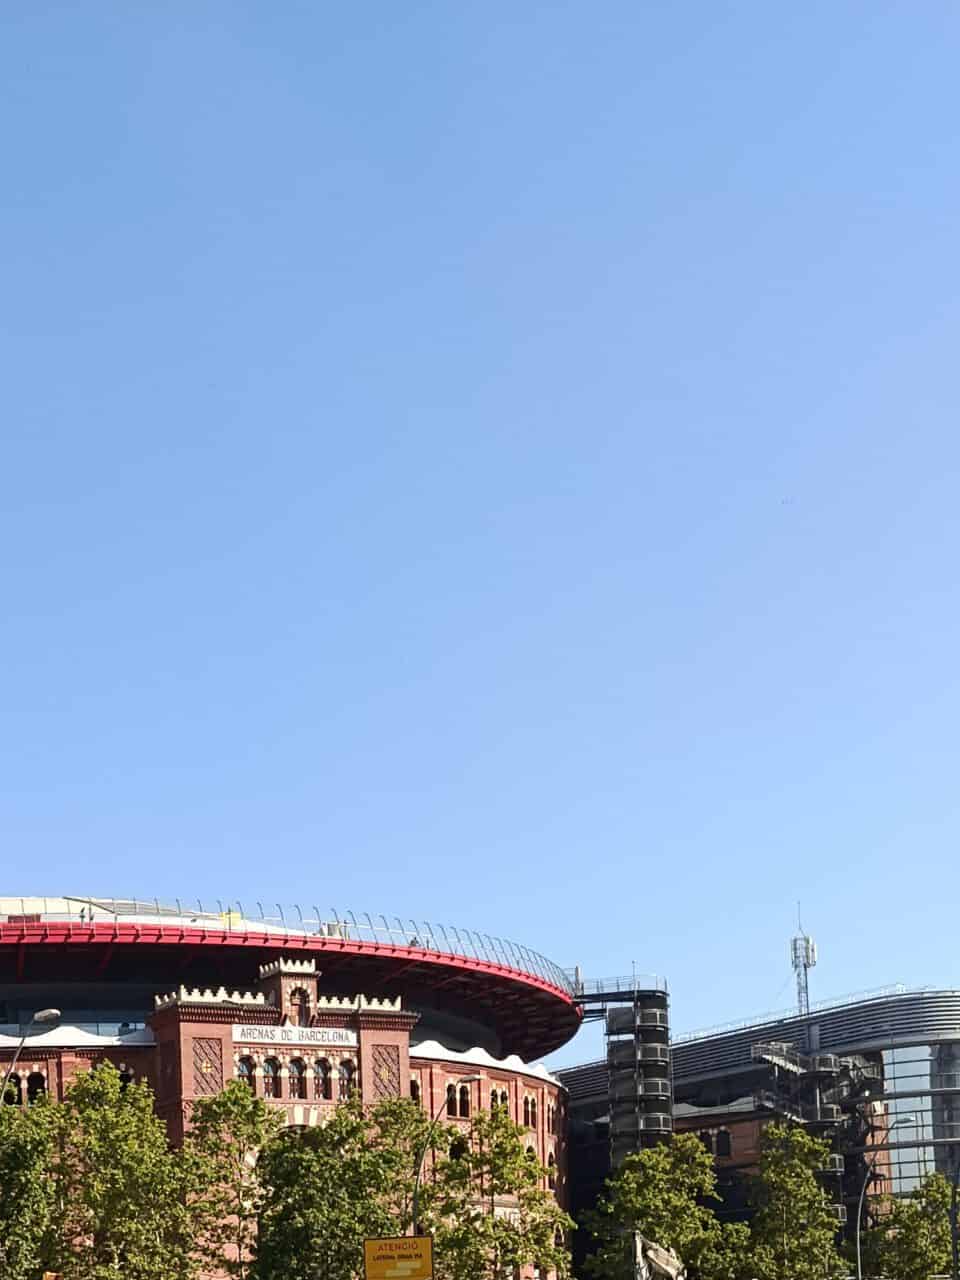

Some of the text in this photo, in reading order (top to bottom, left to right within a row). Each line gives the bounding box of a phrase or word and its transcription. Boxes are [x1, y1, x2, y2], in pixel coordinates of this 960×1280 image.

[240, 1028, 351, 1043] ARENAS DE BARCELONA
